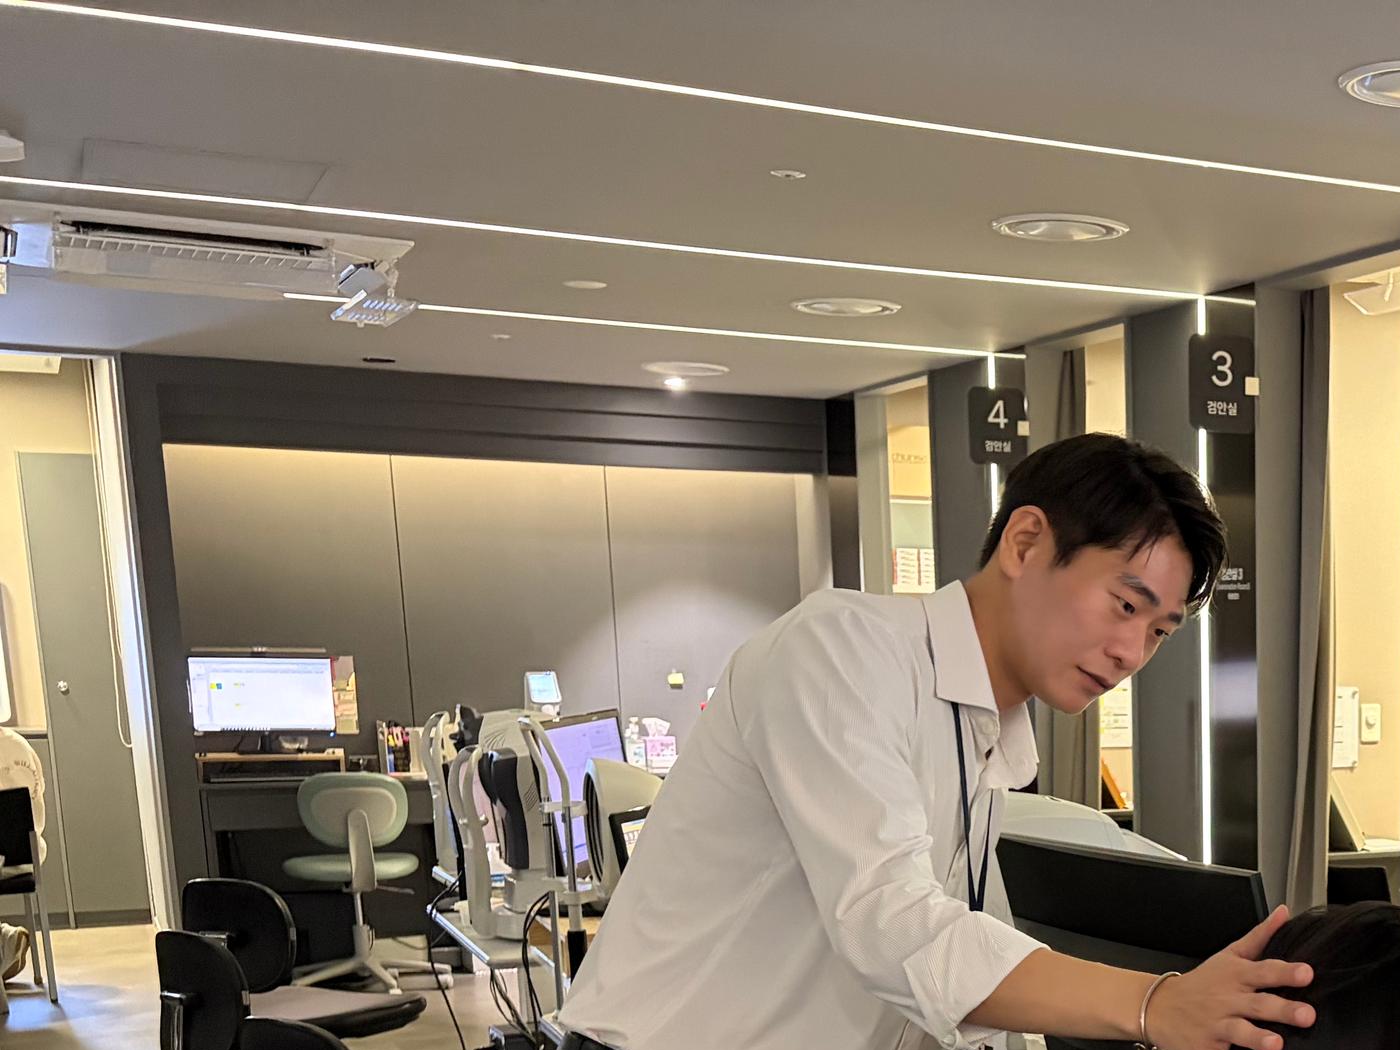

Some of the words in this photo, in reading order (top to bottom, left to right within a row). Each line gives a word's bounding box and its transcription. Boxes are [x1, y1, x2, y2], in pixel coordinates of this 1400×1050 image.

[1211, 350, 1233, 387] 3
[987, 399, 1009, 429] 4
[1207, 400, 1238, 416] 검안실
